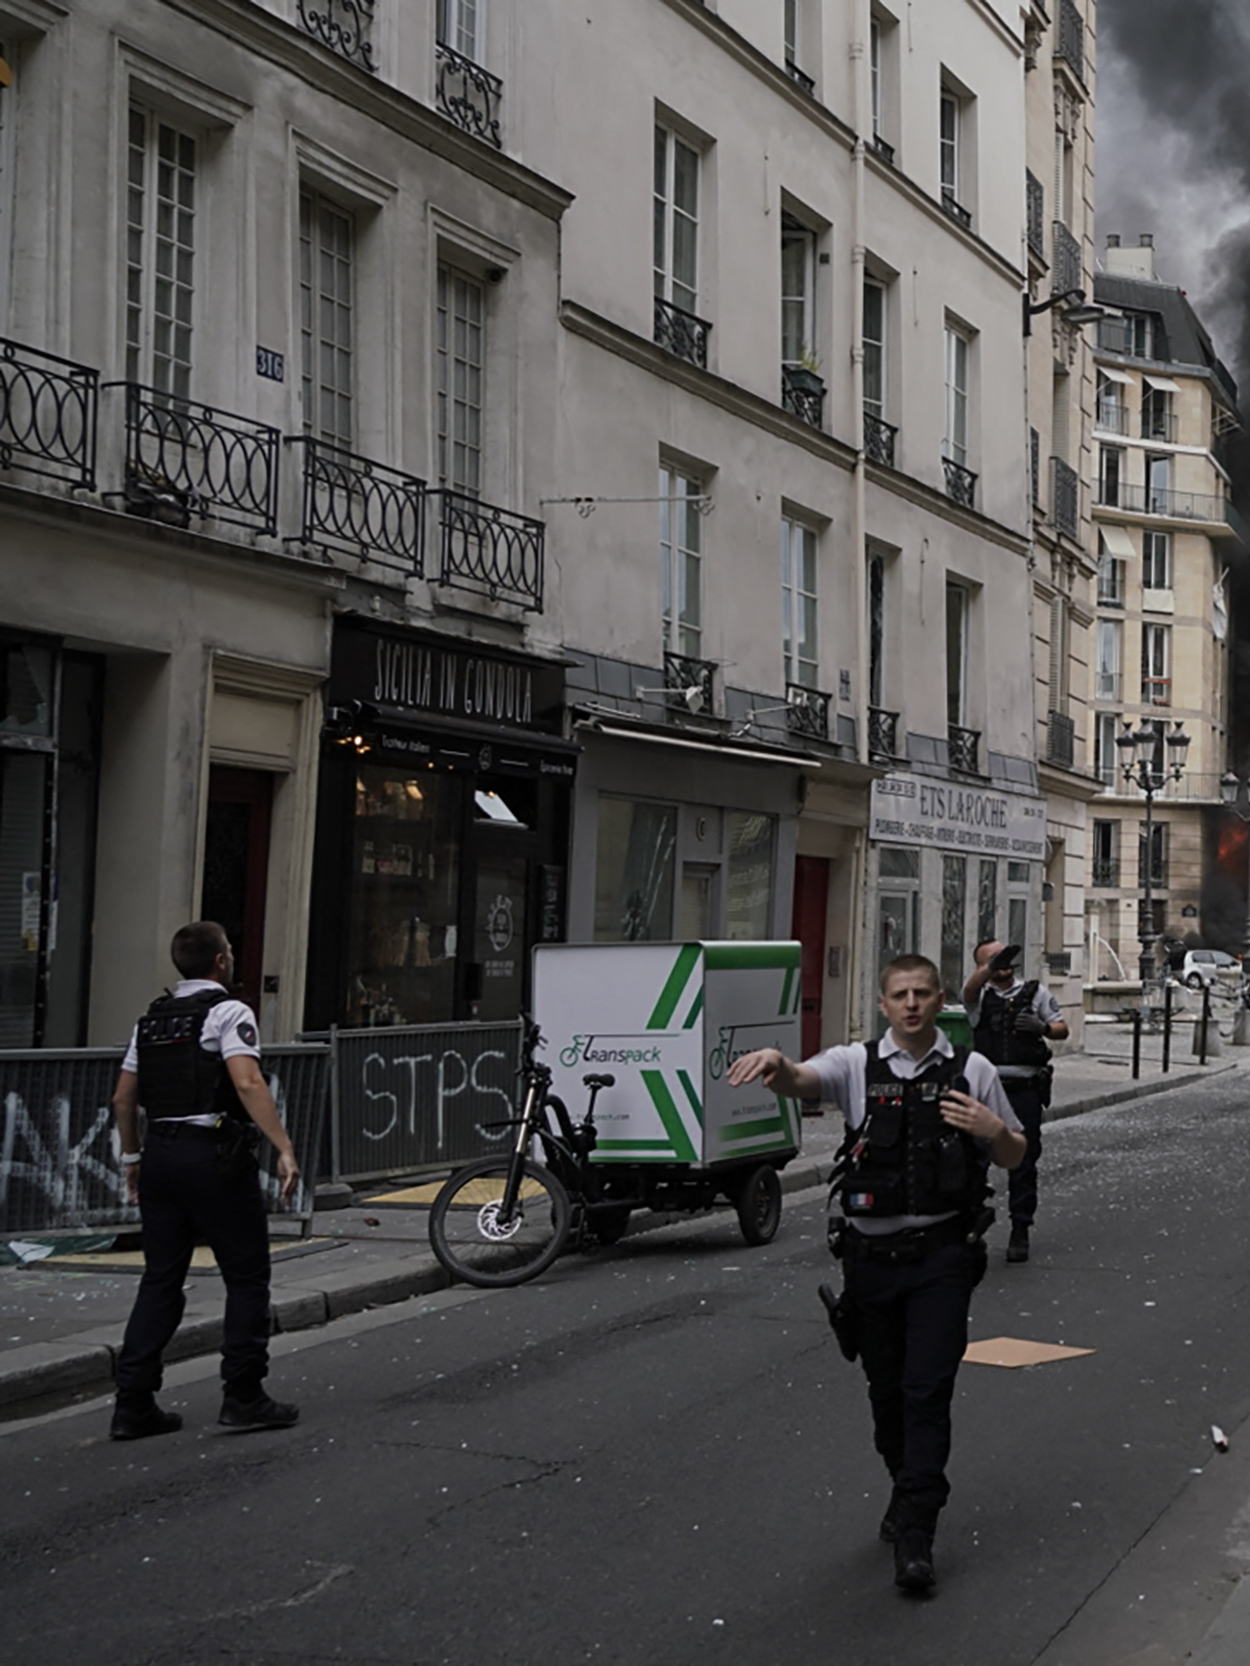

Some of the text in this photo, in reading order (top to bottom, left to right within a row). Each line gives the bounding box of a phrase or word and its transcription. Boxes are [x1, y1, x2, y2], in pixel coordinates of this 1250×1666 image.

[257, 349, 283, 379] 316
[374, 638, 532, 723] SICILIA IN GONDOLA
[919, 784, 945, 820] ETS
[947, 789, 1008, 829] LAROCHE
[141, 1015, 194, 1041] POLICE
[362, 1049, 514, 1149] STPS
